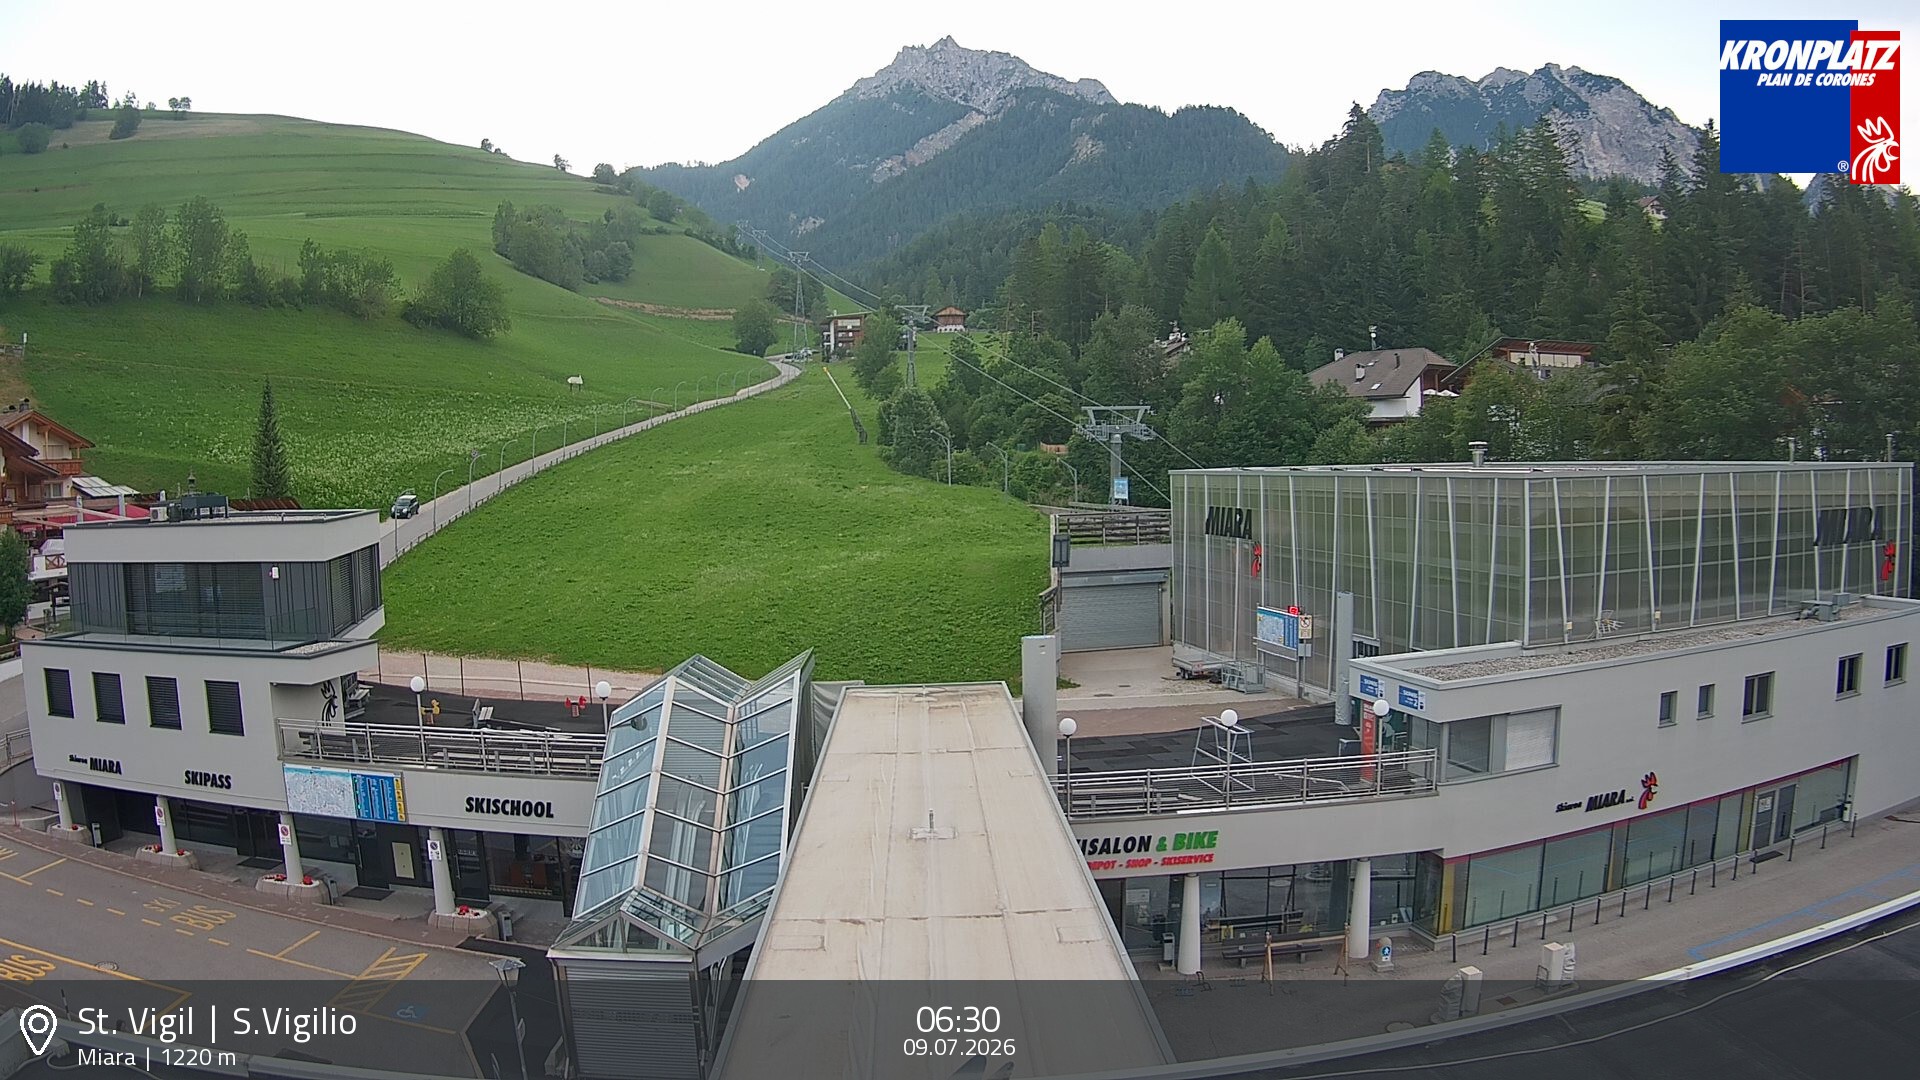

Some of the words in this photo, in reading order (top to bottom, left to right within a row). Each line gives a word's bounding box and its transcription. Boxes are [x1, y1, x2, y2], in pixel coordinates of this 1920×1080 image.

[1205, 506, 1252, 540] MIARA
[89, 757, 122, 775] MIARA
[184, 770, 232, 790] SKIPASS
[465, 796, 554, 818] SKISCHOOL
[1585, 789, 1626, 813] MIARA
[1155, 836, 1168, 852] &
[1172, 830, 1219, 851] BIKE
[1125, 858, 1152, 869] SHOP
[1160, 853, 1215, 866] SKISERVICE
[143, 896, 182, 912] SKI
[169, 905, 238, 931] BUS
